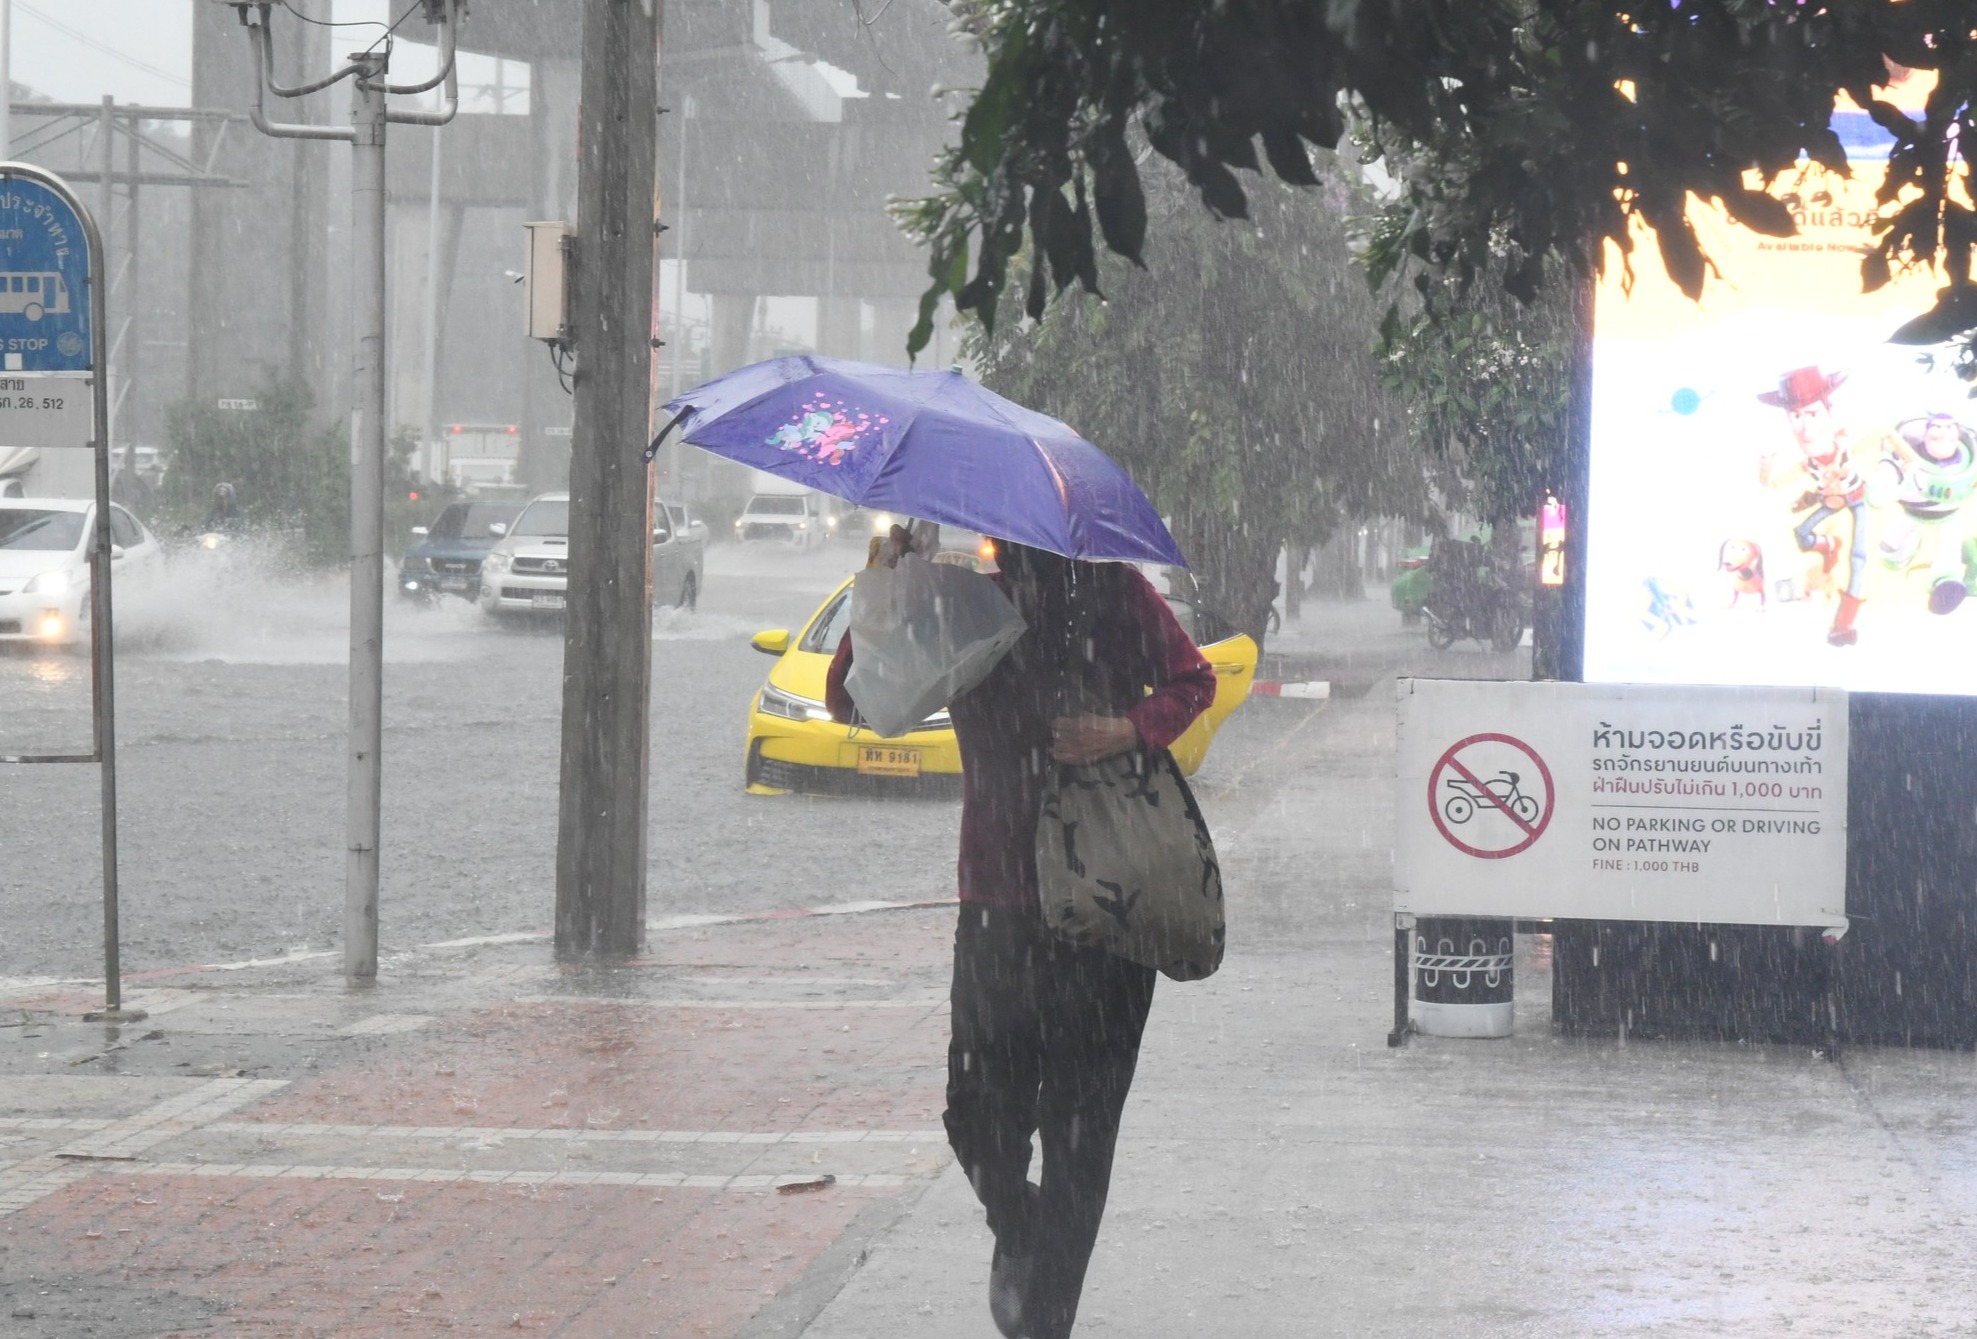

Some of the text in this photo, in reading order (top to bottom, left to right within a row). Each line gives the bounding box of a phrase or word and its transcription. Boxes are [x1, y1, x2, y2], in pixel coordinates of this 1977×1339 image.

[8, 338, 48, 351] STOP
[1593, 718, 1821, 752] ห้ามจอดหรือขับขี่
[1592, 754, 1822, 774] รถจักรยานยนต์บนทางเท้า
[1593, 776, 1822, 800] ฝ่าฝืนปรับไม่เกิน 1,000 บาท
[1593, 817, 1821, 835] NO PARKING OR DRIVING
[1593, 837, 1711, 853] ON PATHWAY
[1593, 859, 1623, 871] FINE
[1673, 861, 1700, 873] THB
